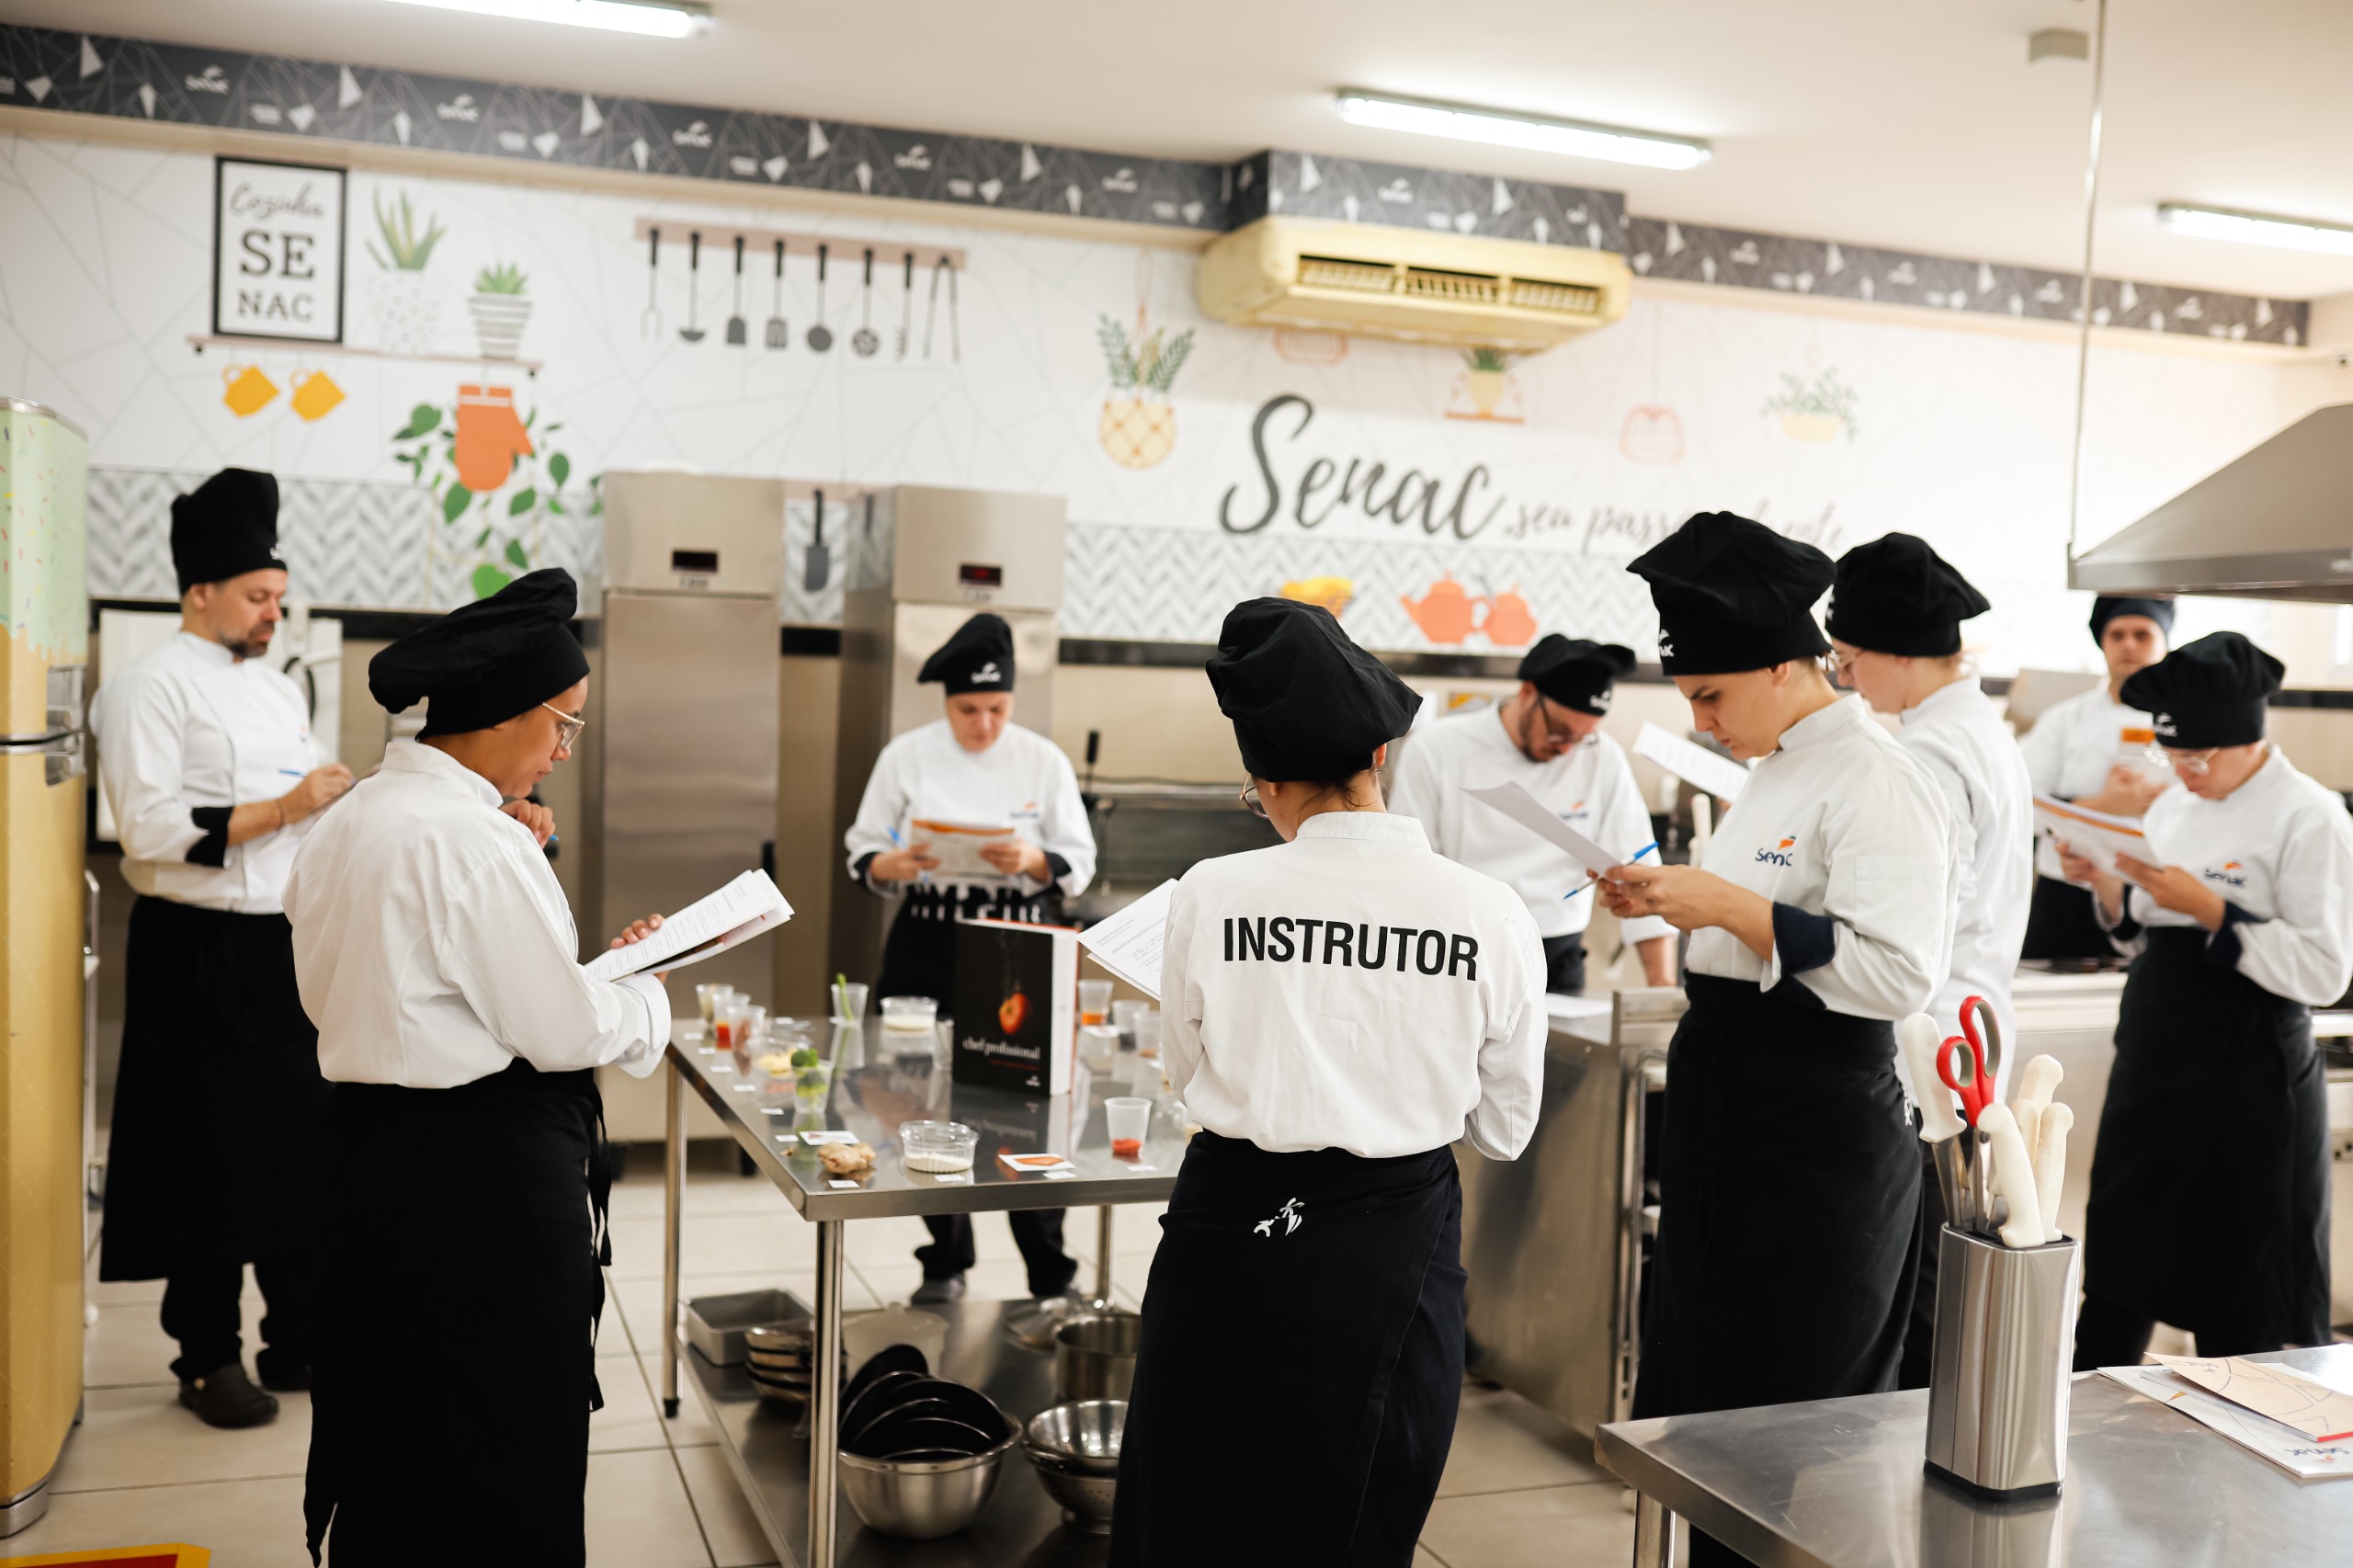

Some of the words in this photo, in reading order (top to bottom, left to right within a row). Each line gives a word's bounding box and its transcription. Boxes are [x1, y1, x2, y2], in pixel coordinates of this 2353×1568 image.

[241, 230, 314, 279] SE
[238, 290, 314, 323] NAC
[1580, 504, 1693, 557] pass
[1224, 917, 1479, 981] INSTRUTOR
[962, 1036, 985, 1051] chef
[984, 1041, 1040, 1060] profissional
